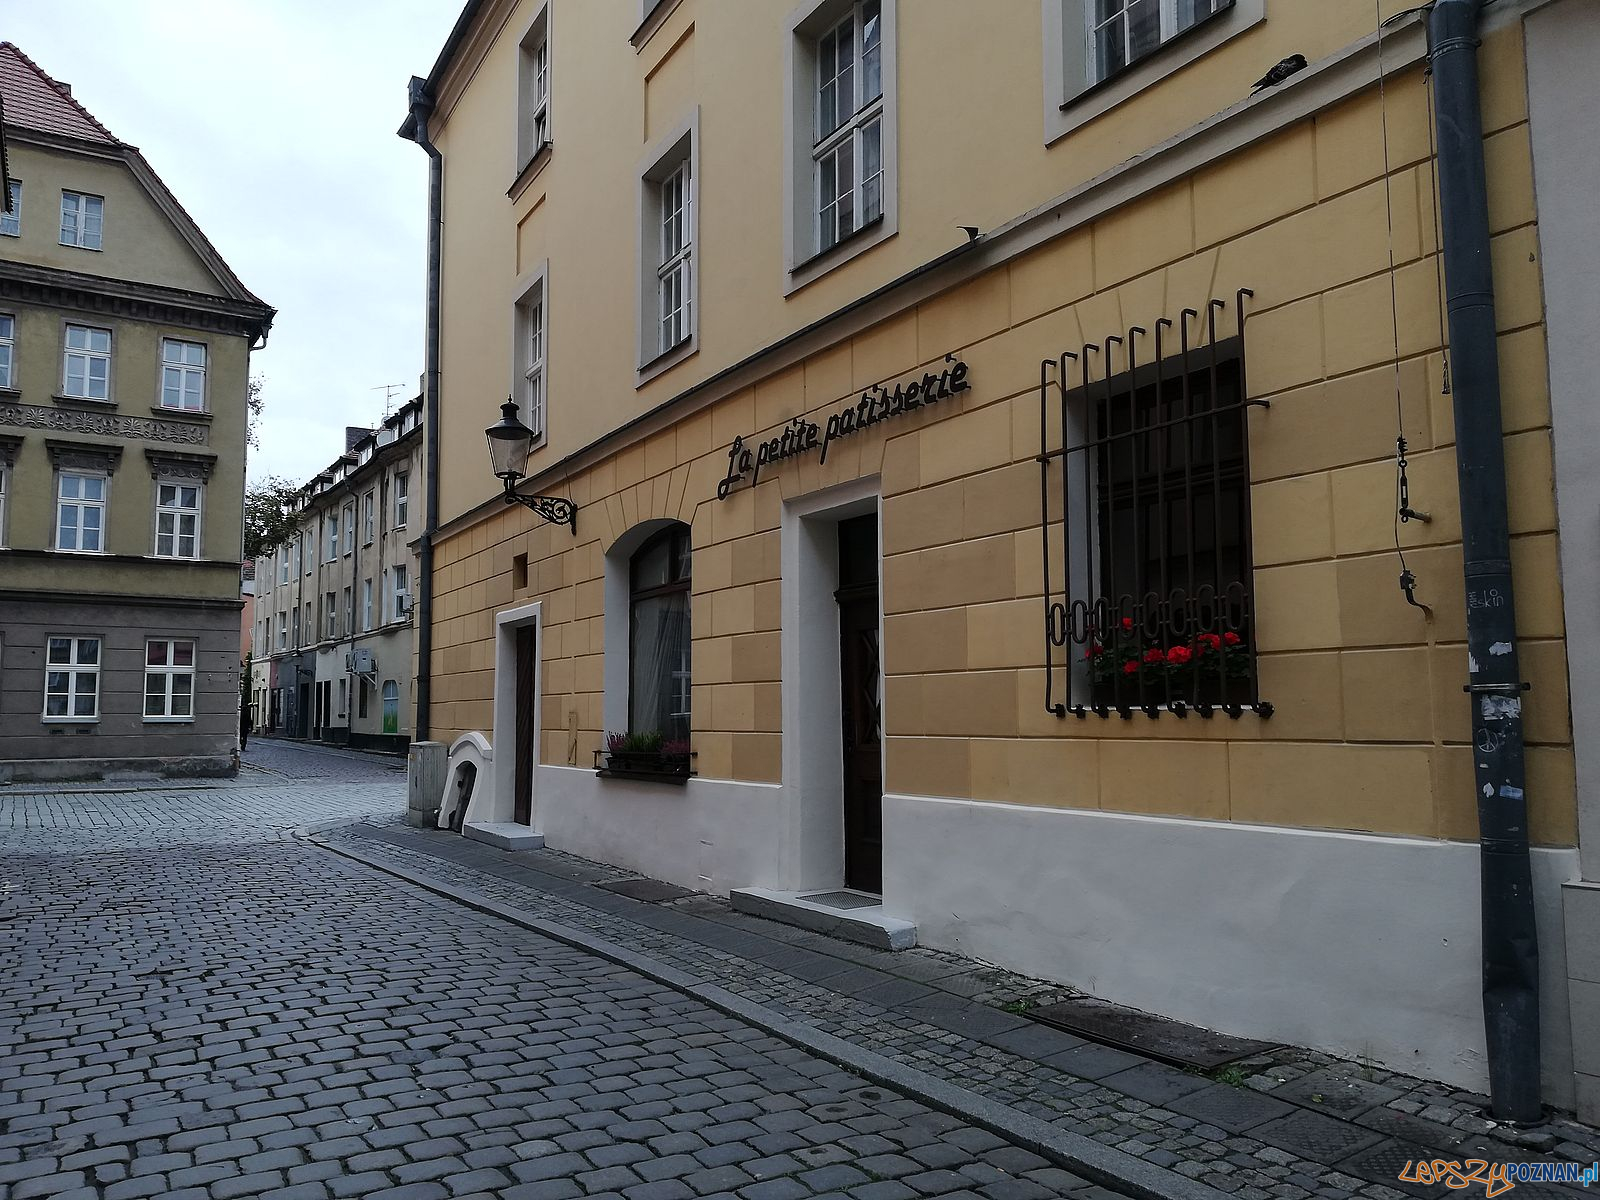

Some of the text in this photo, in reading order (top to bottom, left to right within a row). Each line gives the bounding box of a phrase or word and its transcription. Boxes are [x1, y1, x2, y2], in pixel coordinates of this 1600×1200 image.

[718, 353, 971, 501] La petite patisserie
